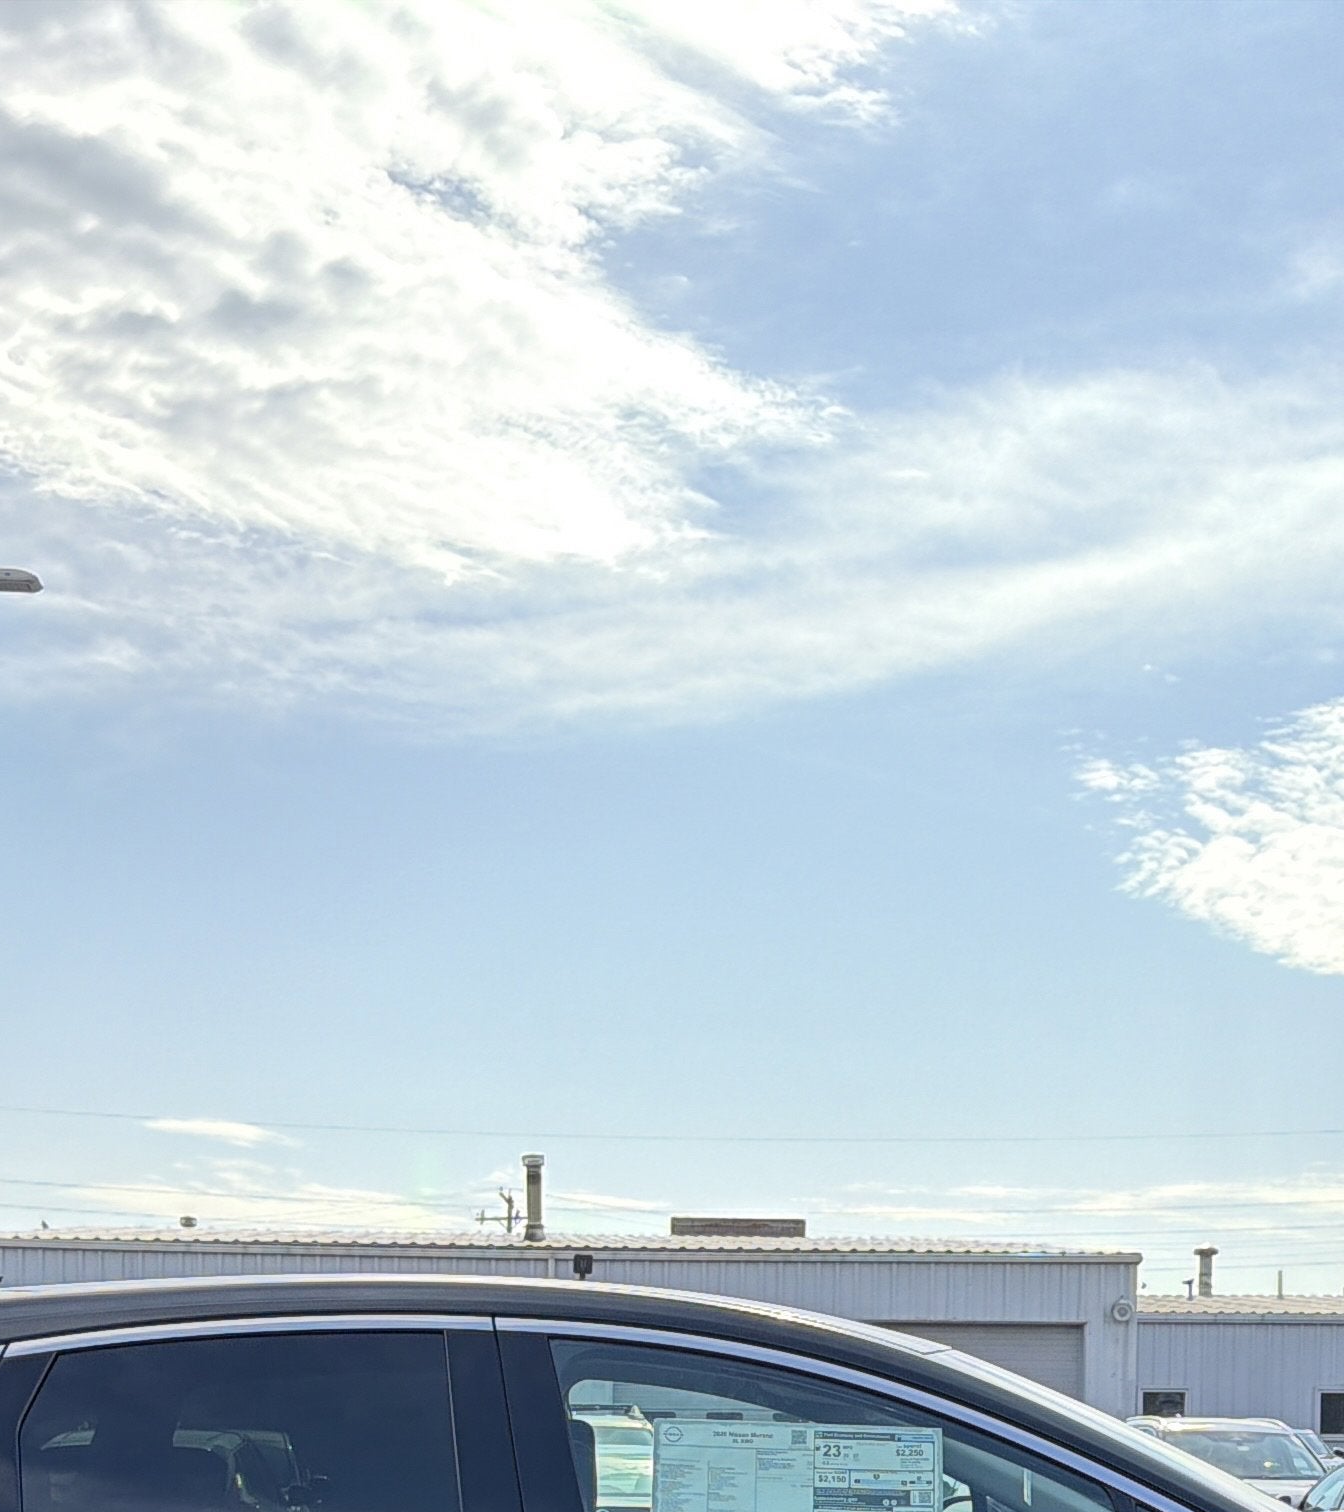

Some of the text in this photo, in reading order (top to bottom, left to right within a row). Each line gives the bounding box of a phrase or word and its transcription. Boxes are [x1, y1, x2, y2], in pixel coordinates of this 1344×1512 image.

[822, 1444, 842, 1458] 23
[895, 1449, 924, 1458] $2,250
[818, 1474, 847, 1484] $2,150
